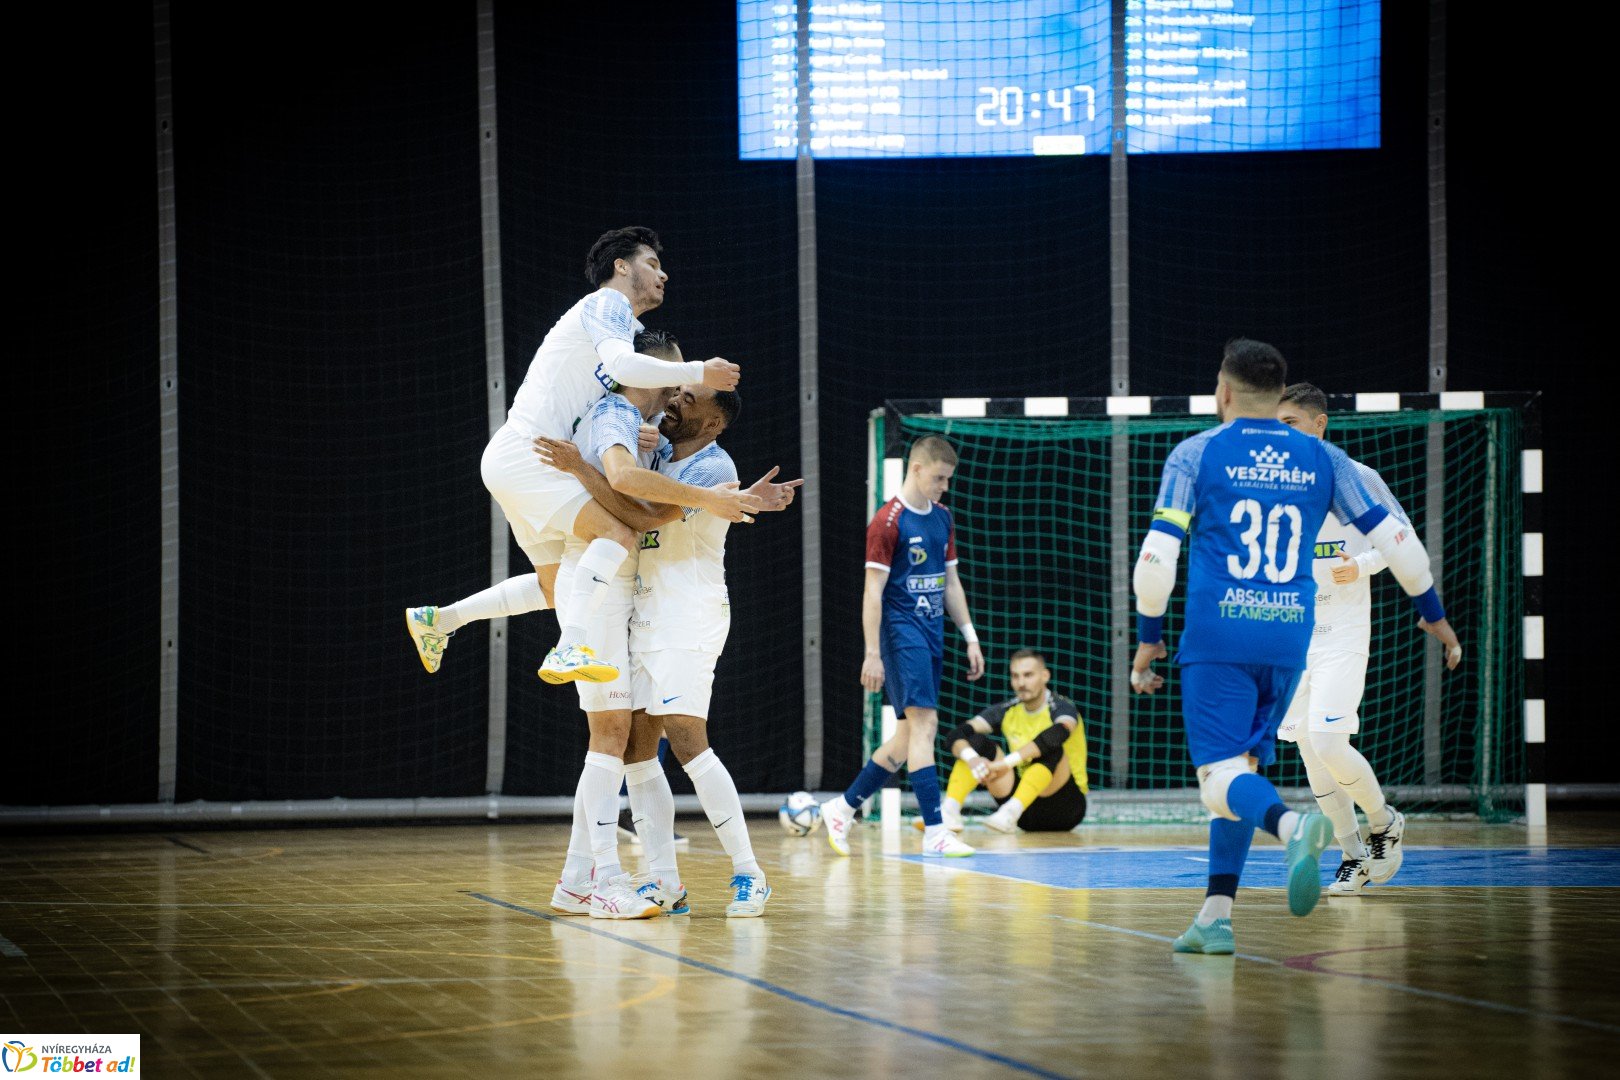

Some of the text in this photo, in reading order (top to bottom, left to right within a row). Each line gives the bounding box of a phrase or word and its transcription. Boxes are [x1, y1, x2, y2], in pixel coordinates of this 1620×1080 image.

[975, 85, 1095, 126] 20:47
[1225, 466, 1316, 485] VESZPRÉM
[1227, 499, 1303, 584] 30
[1223, 587, 1301, 607] ABSOLUTE
[1218, 602, 1306, 623] TEAMSPORT
